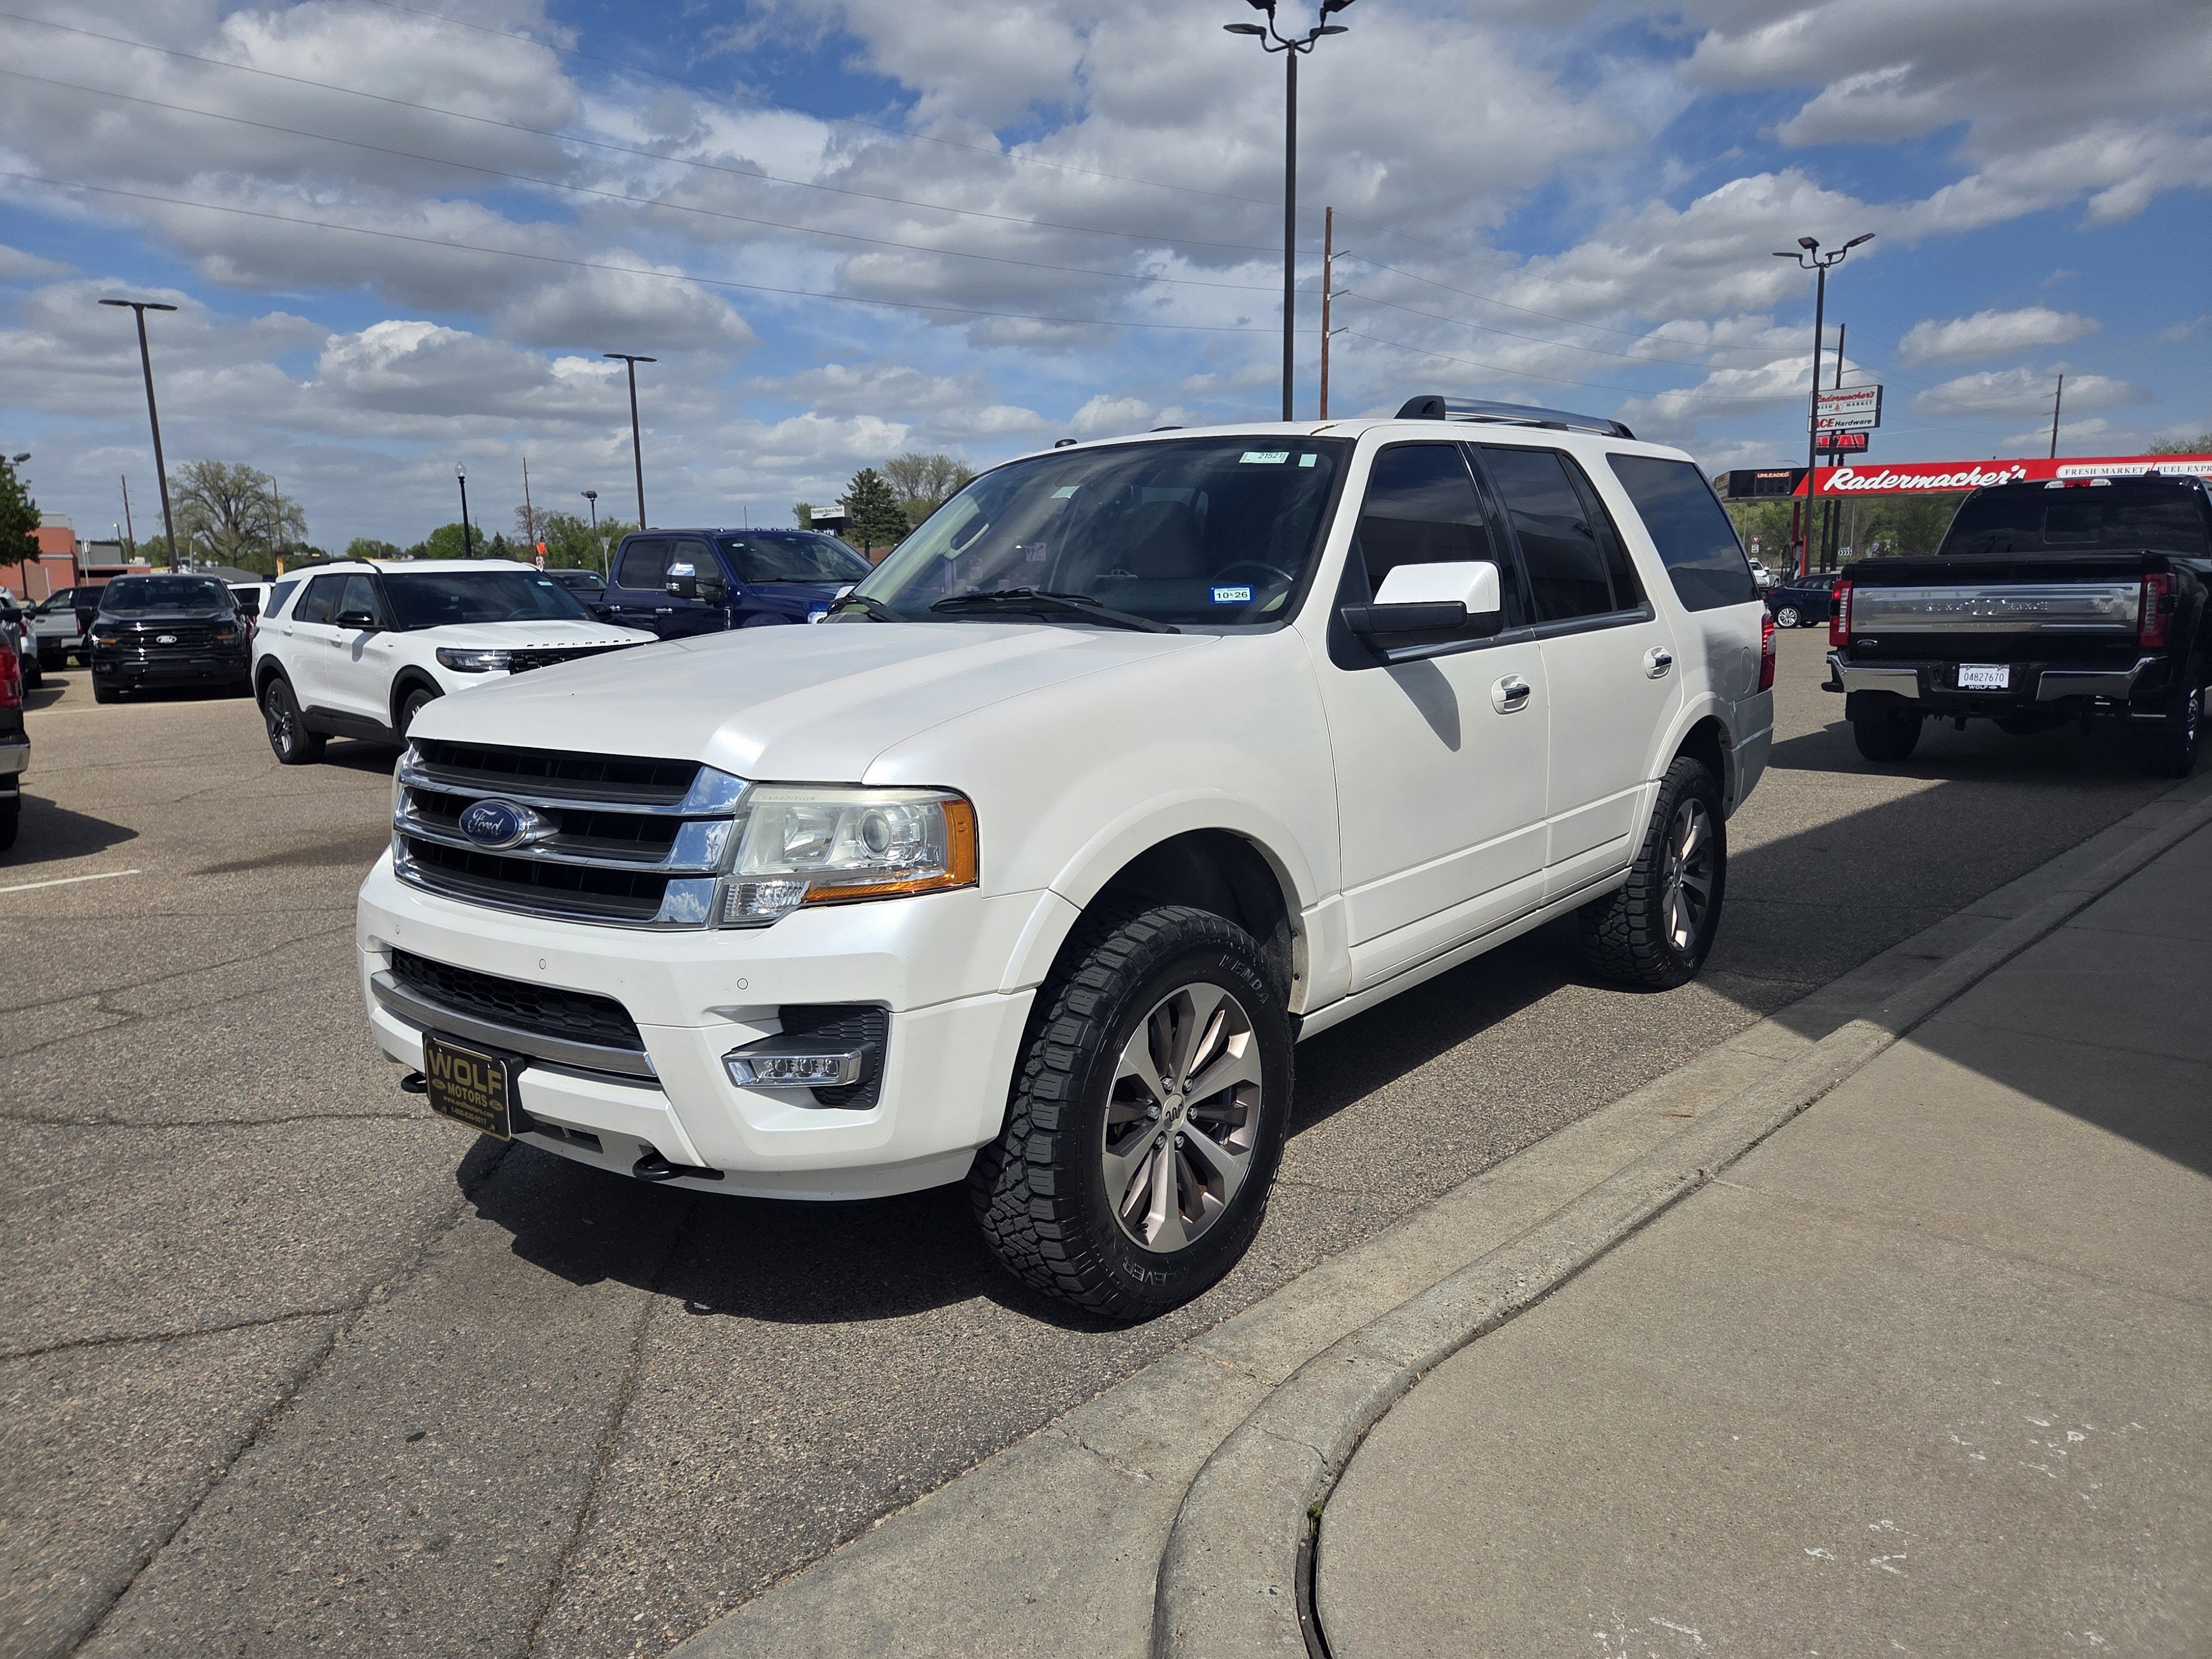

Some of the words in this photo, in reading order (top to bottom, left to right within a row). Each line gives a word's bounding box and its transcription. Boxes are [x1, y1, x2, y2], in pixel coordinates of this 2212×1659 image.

[1823, 465, 2026, 491] Radermacher's
[1964, 672, 2004, 682] 04827670
[468, 808, 504, 835] Ford
[1219, 954, 1269, 1004] KENDA
[429, 1049, 502, 1095] WOLF
[447, 1082, 488, 1108] MOTORS
